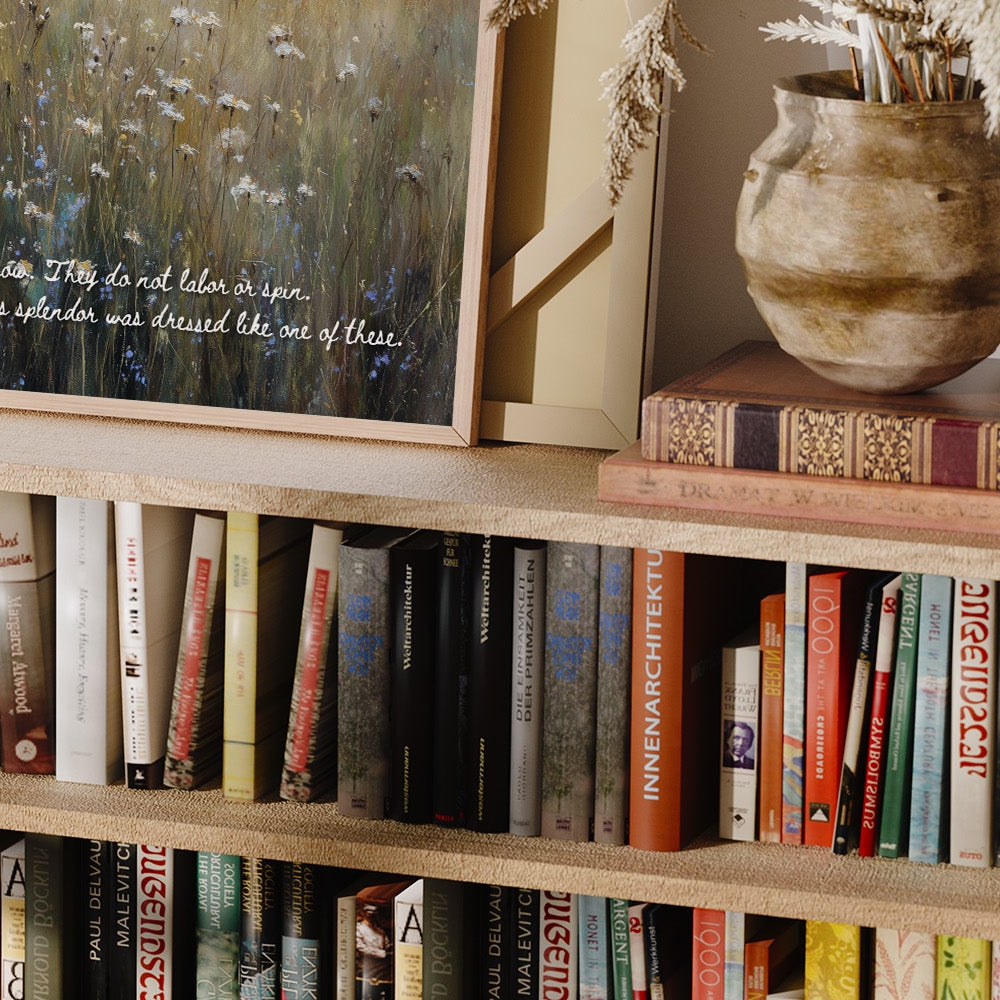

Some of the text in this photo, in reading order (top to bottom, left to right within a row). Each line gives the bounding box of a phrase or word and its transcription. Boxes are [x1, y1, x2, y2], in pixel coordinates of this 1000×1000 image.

[46, 258, 99, 288] They
[106, 262, 131, 286] do
[136, 266, 173, 291] not
[180, 268, 227, 296] labor
[234, 279, 258, 297] or
[262, 283, 311, 306] spin.
[15, 297, 99, 329] splendor
[106, 312, 145, 329] was
[152, 308, 230, 334] dressed
[236, 310, 273, 339] like
[280, 325, 312, 342] one
[319, 320, 340, 350] of
[345, 319, 402, 347] these.
[7, 595, 32, 714] Margaret Atwood
[403, 564, 412, 671] Weltarchitektur
[524, 558, 536, 722] DER PRIMZAHLEN
[643, 548, 664, 801] INNENARCHITEKTU
[478, 737, 486, 821] westermann
[89, 840, 101, 962] PAUL DELVAU
[629, 917, 642, 934] 2
[587, 914, 598, 970] MONET IN
[650, 926, 661, 984] & Werkkunst
[695, 920, 721, 987] 1900
